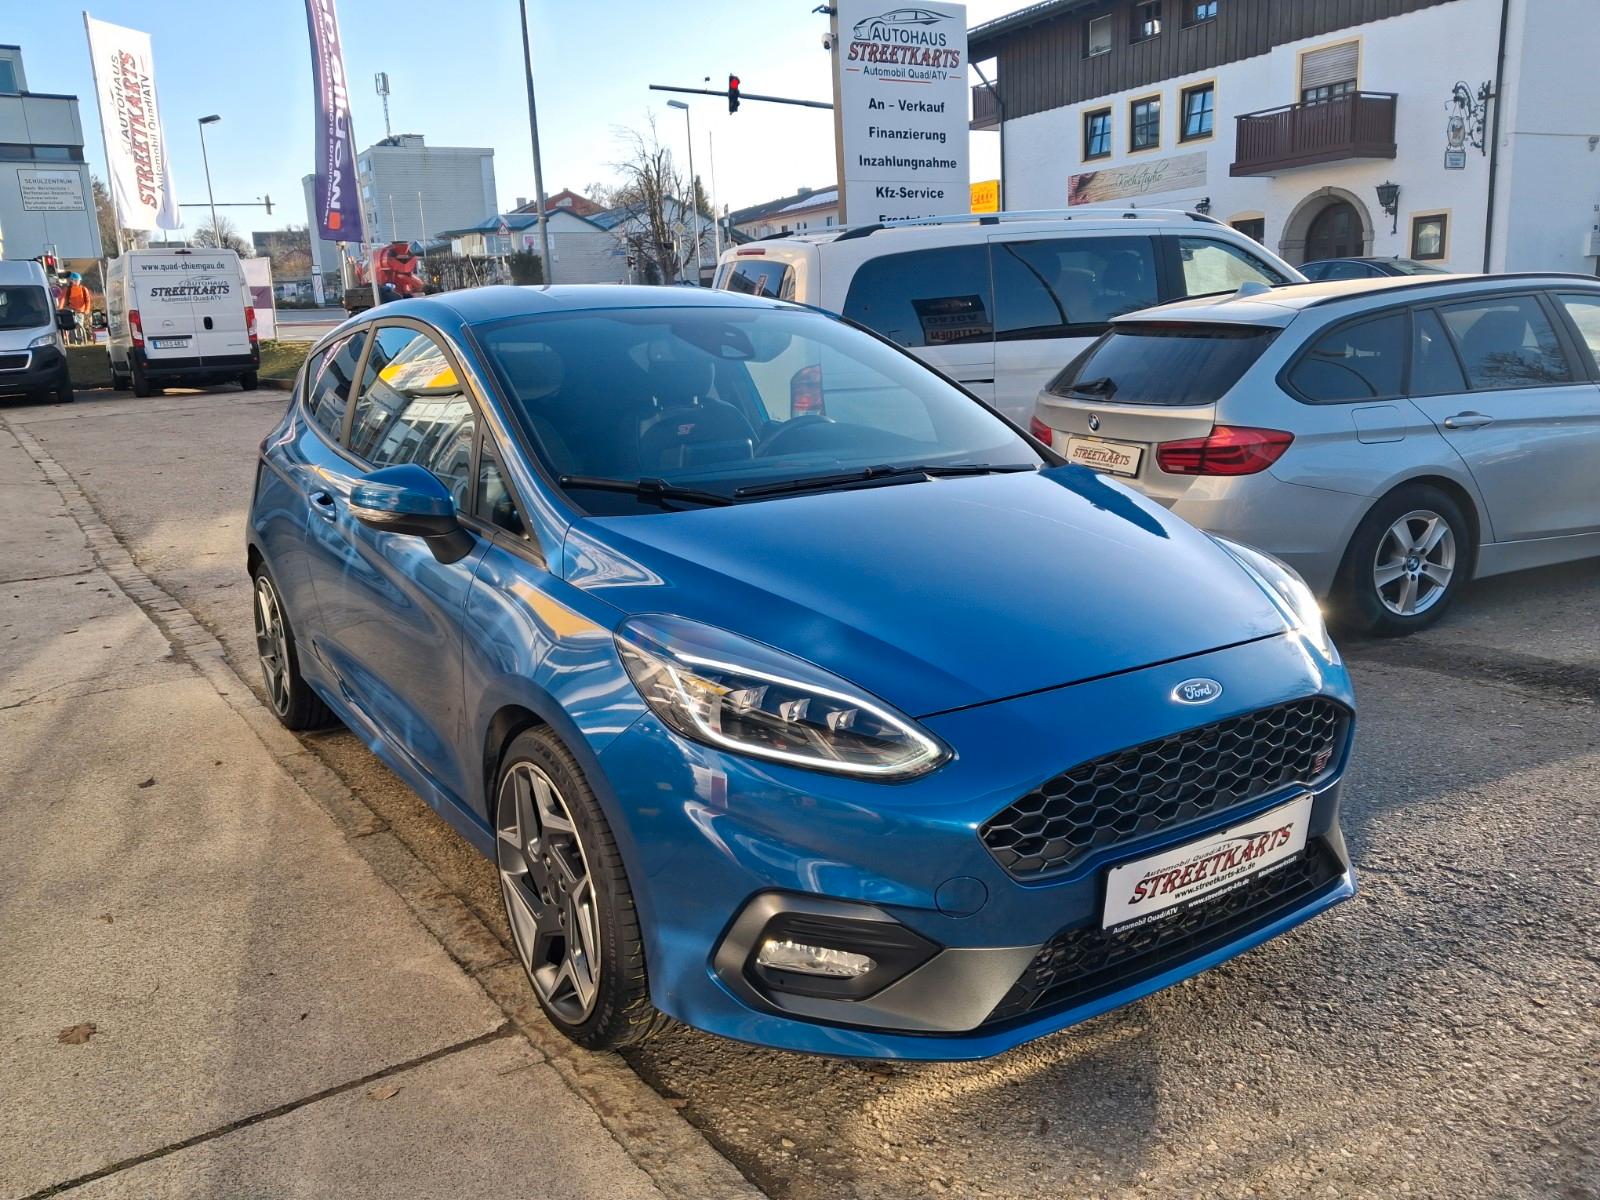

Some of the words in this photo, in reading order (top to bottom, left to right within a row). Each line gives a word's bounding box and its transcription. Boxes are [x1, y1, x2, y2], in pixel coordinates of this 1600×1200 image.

[872, 27, 947, 47] AUTOHAUS
[847, 42, 961, 69] STREETKARTS
[863, 66, 905, 78] Automobil
[908, 69, 948, 81] Quad/ATV
[111, 54, 130, 139] AUTOHAUS
[868, 98, 885, 110] An
[898, 99, 945, 113] Verkauf
[118, 49, 158, 210] STREETKARTS
[868, 126, 947, 144] Finanzierung
[859, 155, 958, 170] Inzahlungnahme
[876, 186, 944, 199] Kfz-Service
[141, 262, 225, 271] www.quad-chiemgau.de
[150, 285, 230, 297] STREETKARTS
[1072, 447, 1131, 466] STREETKARTS
[1184, 683, 1212, 700] Ford
[1128, 822, 1295, 905] STREETKARTS
[1143, 855, 1191, 878] Automobil
[1174, 861, 1256, 900] www.streetkarts-kfz.de
[1112, 917, 1147, 935] Automobil
[1147, 906, 1179, 923] Quad/ATV
